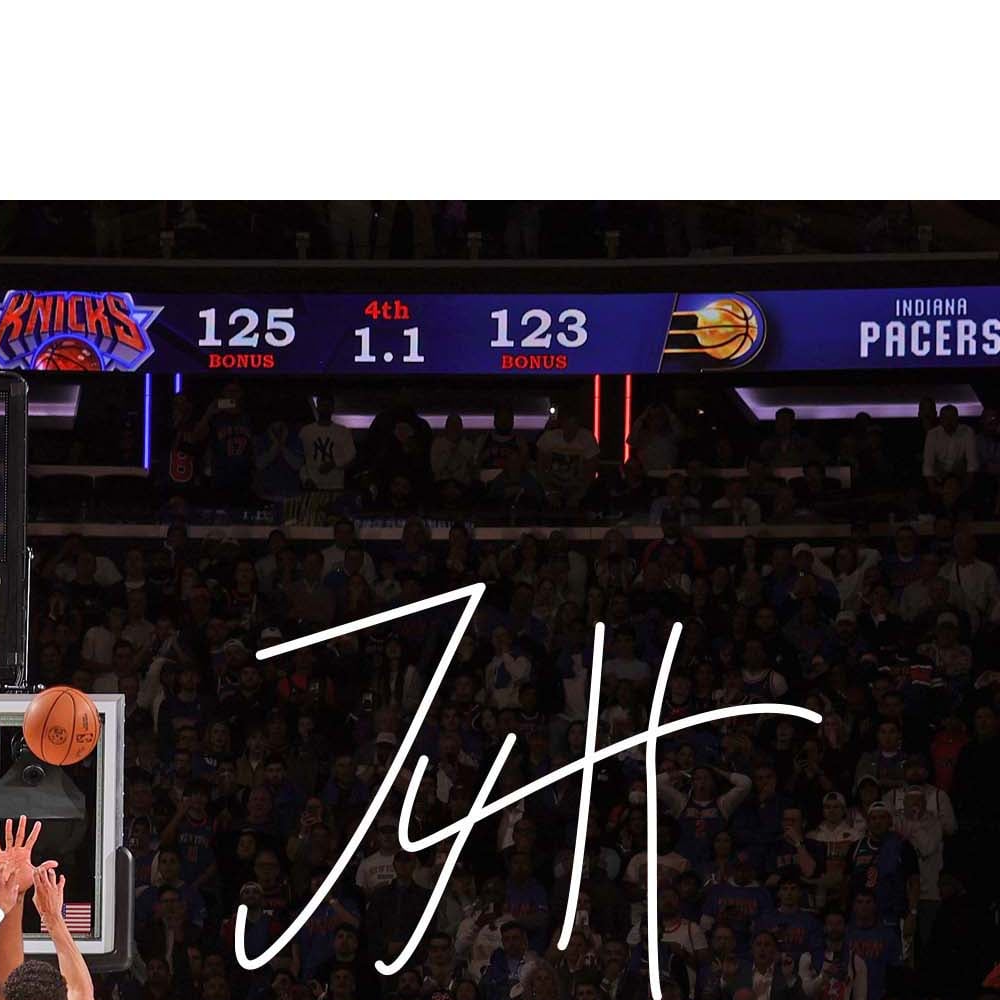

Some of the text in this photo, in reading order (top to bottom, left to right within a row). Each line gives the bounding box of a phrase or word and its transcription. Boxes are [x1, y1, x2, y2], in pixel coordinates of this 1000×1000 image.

[364, 300, 409, 320] 4th
[896, 297, 967, 317] INDIANA
[198, 307, 296, 348] 125
[490, 308, 588, 349] 123
[860, 318, 1000, 358] PACERS
[354, 326, 425, 363] 1.1
[209, 354, 275, 368] BONUS
[502, 355, 567, 369] BONUS
